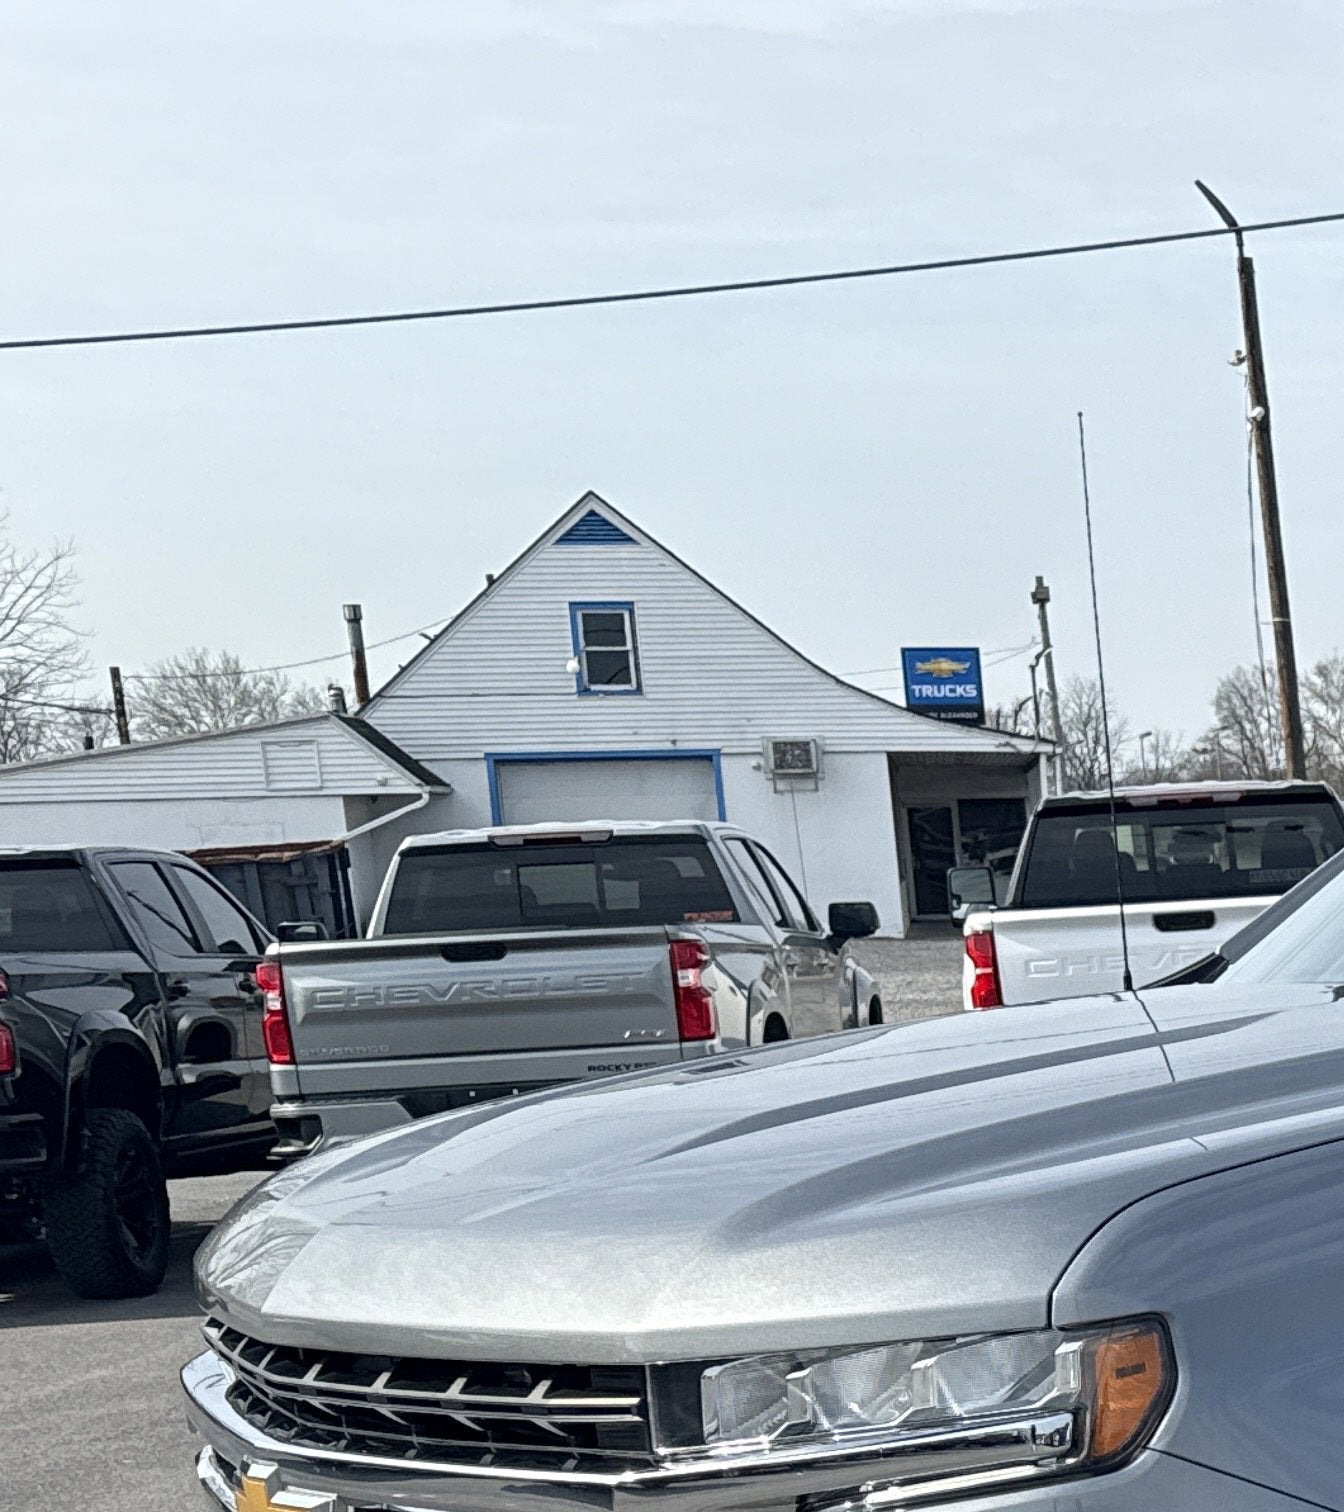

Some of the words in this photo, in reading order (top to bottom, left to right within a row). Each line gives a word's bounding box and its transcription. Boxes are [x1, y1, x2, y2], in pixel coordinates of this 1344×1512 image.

[911, 684, 978, 698] TRUCKS
[310, 971, 648, 1010] CHEVROLET
[587, 1063, 633, 1073] ROCKY
